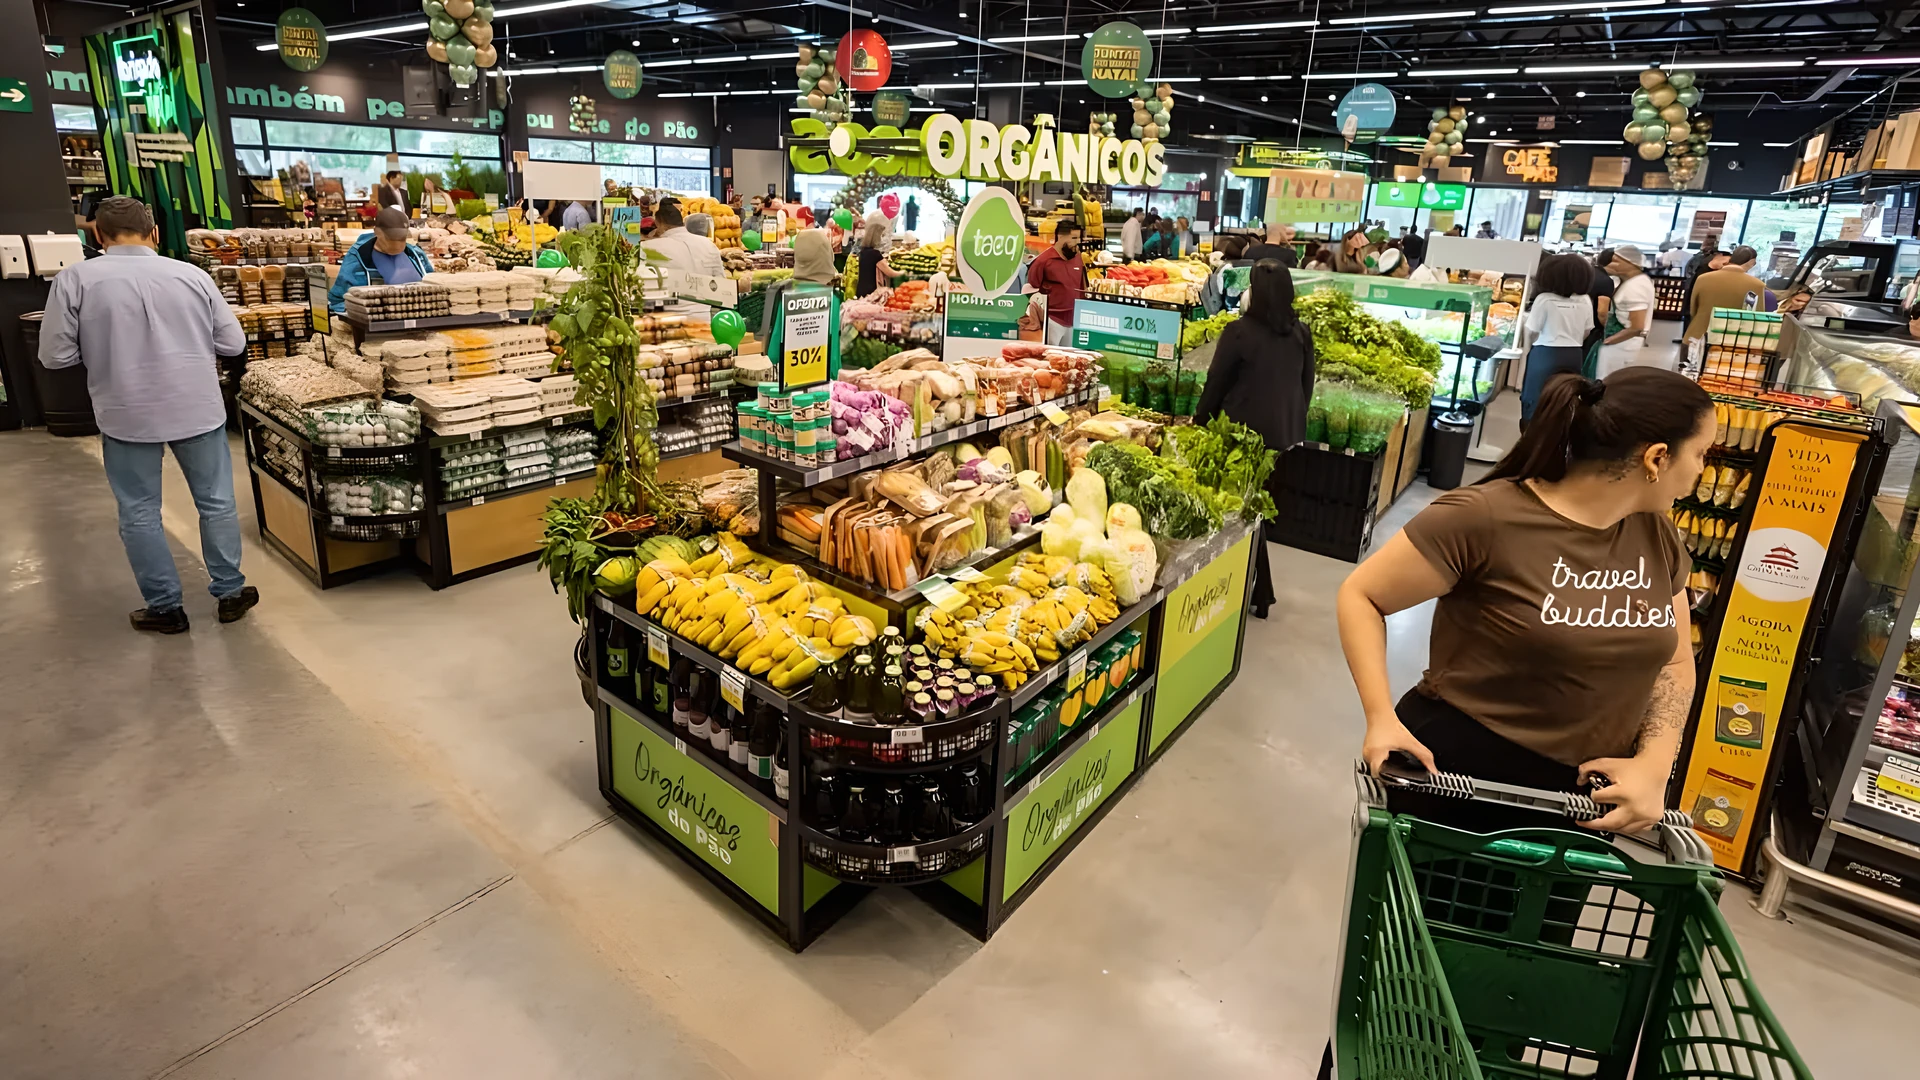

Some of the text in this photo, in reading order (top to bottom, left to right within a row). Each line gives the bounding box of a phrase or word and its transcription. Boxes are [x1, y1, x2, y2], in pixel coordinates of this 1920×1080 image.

[625, 116, 651, 137] do
[921, 112, 1165, 187] ORGÂNICOS
[790, 345, 822, 367] 30%
[1788, 448, 1831, 464] VIDA
[1551, 556, 1652, 590] travel
[634, 741, 741, 851] Orgânicos
[668, 807, 690, 835] do
